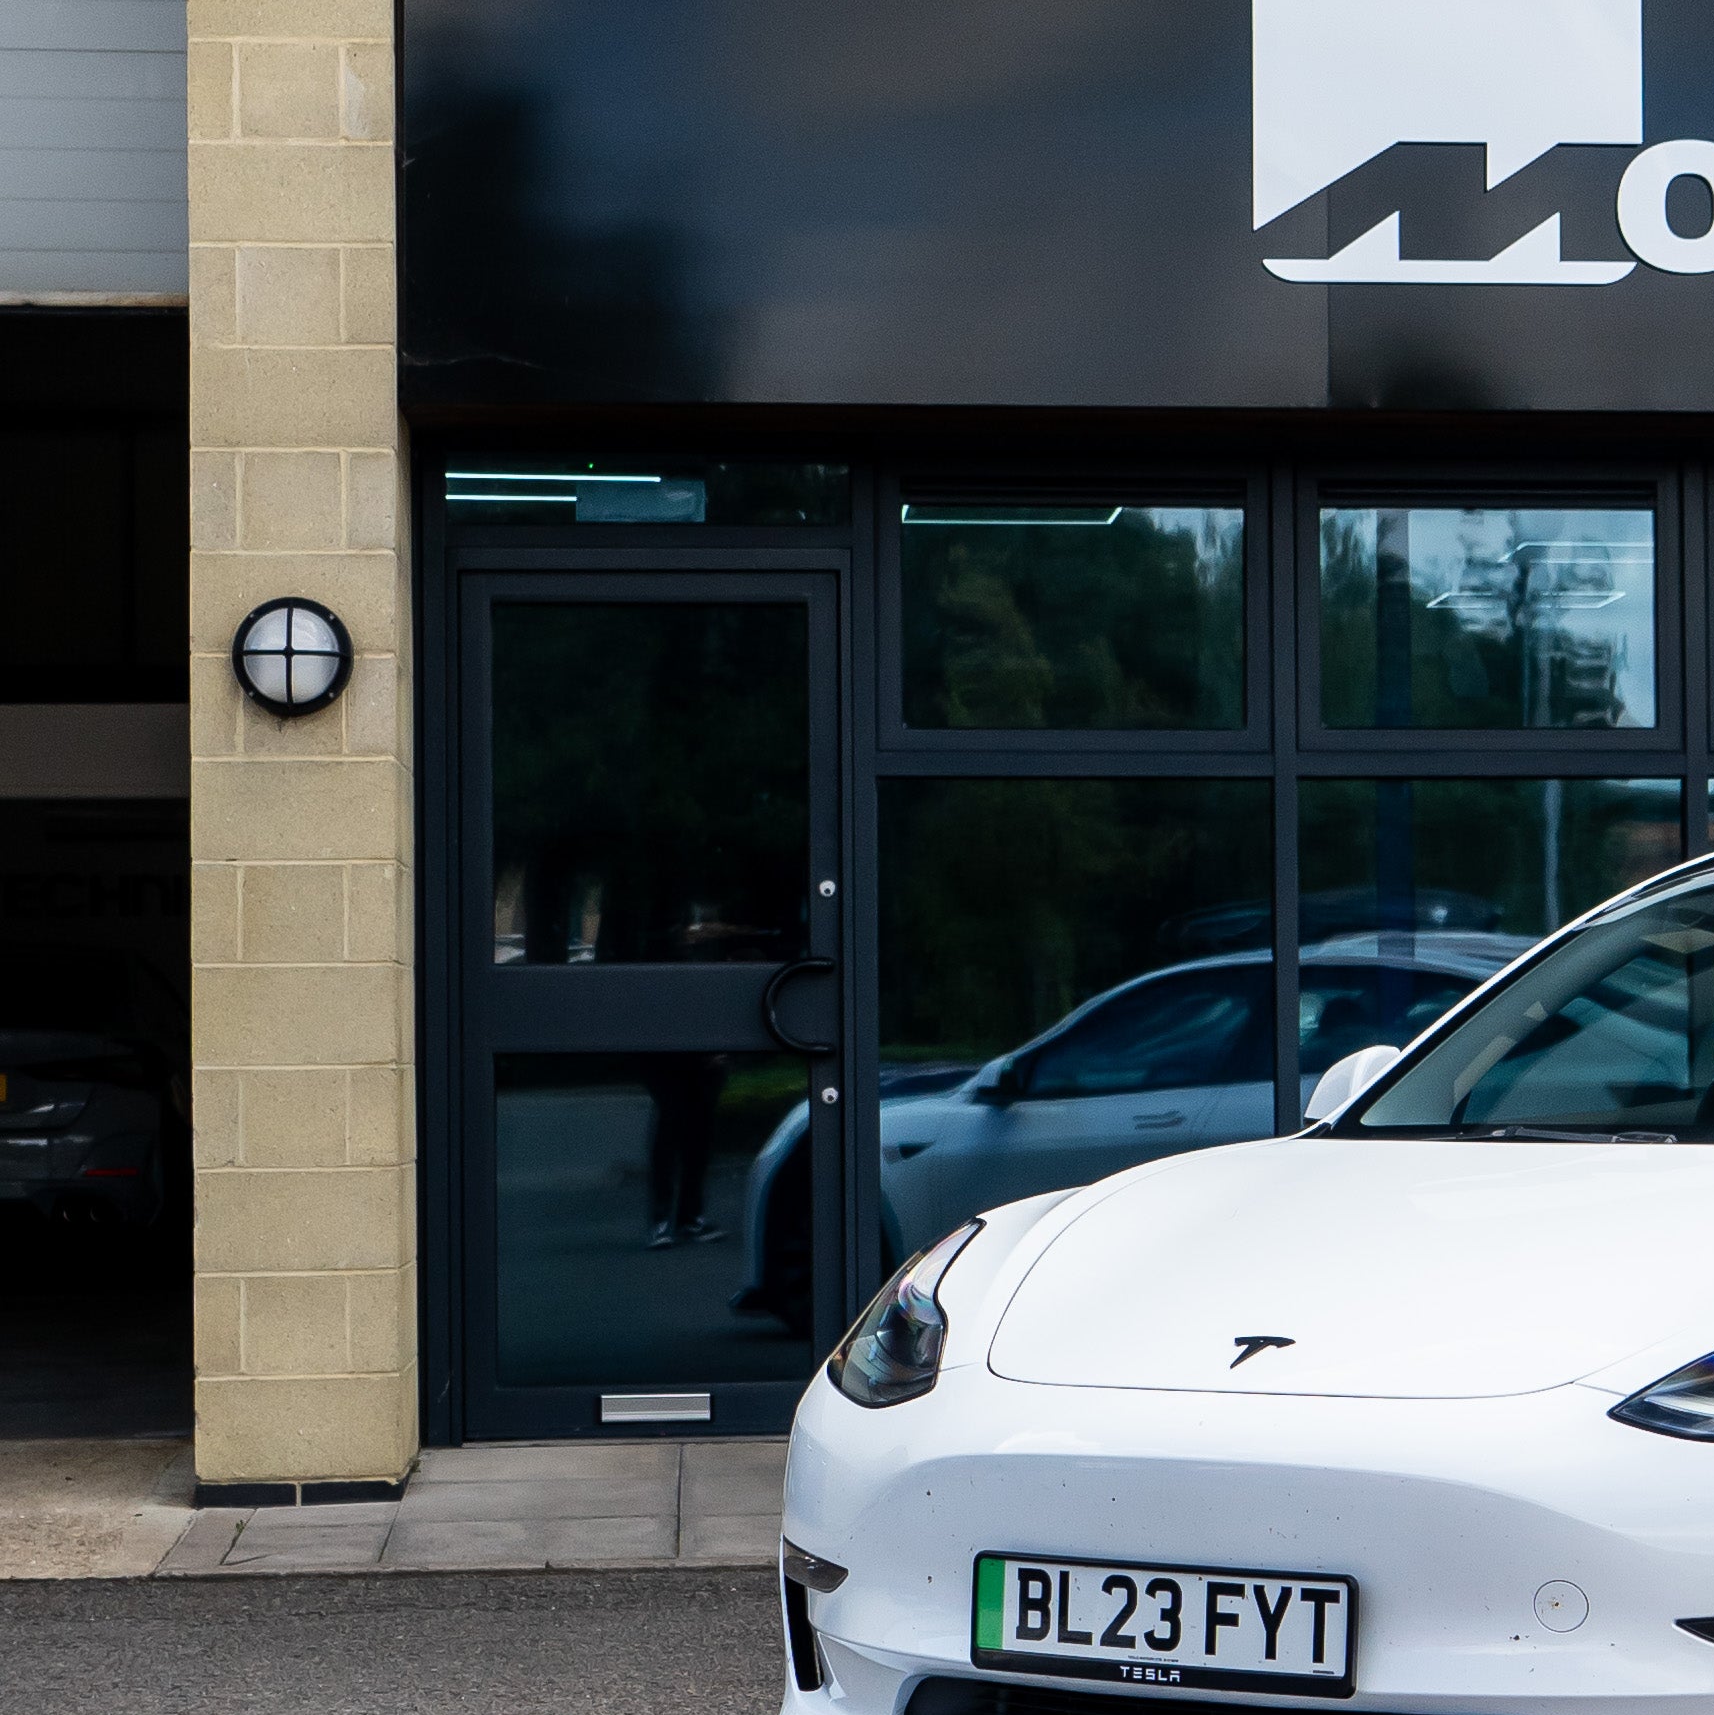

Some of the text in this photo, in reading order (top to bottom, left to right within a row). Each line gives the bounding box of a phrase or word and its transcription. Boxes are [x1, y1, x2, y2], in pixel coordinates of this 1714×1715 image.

[1015, 1567, 1341, 1664] BL23 FYT
[1119, 1665, 1181, 1683] TESLA
